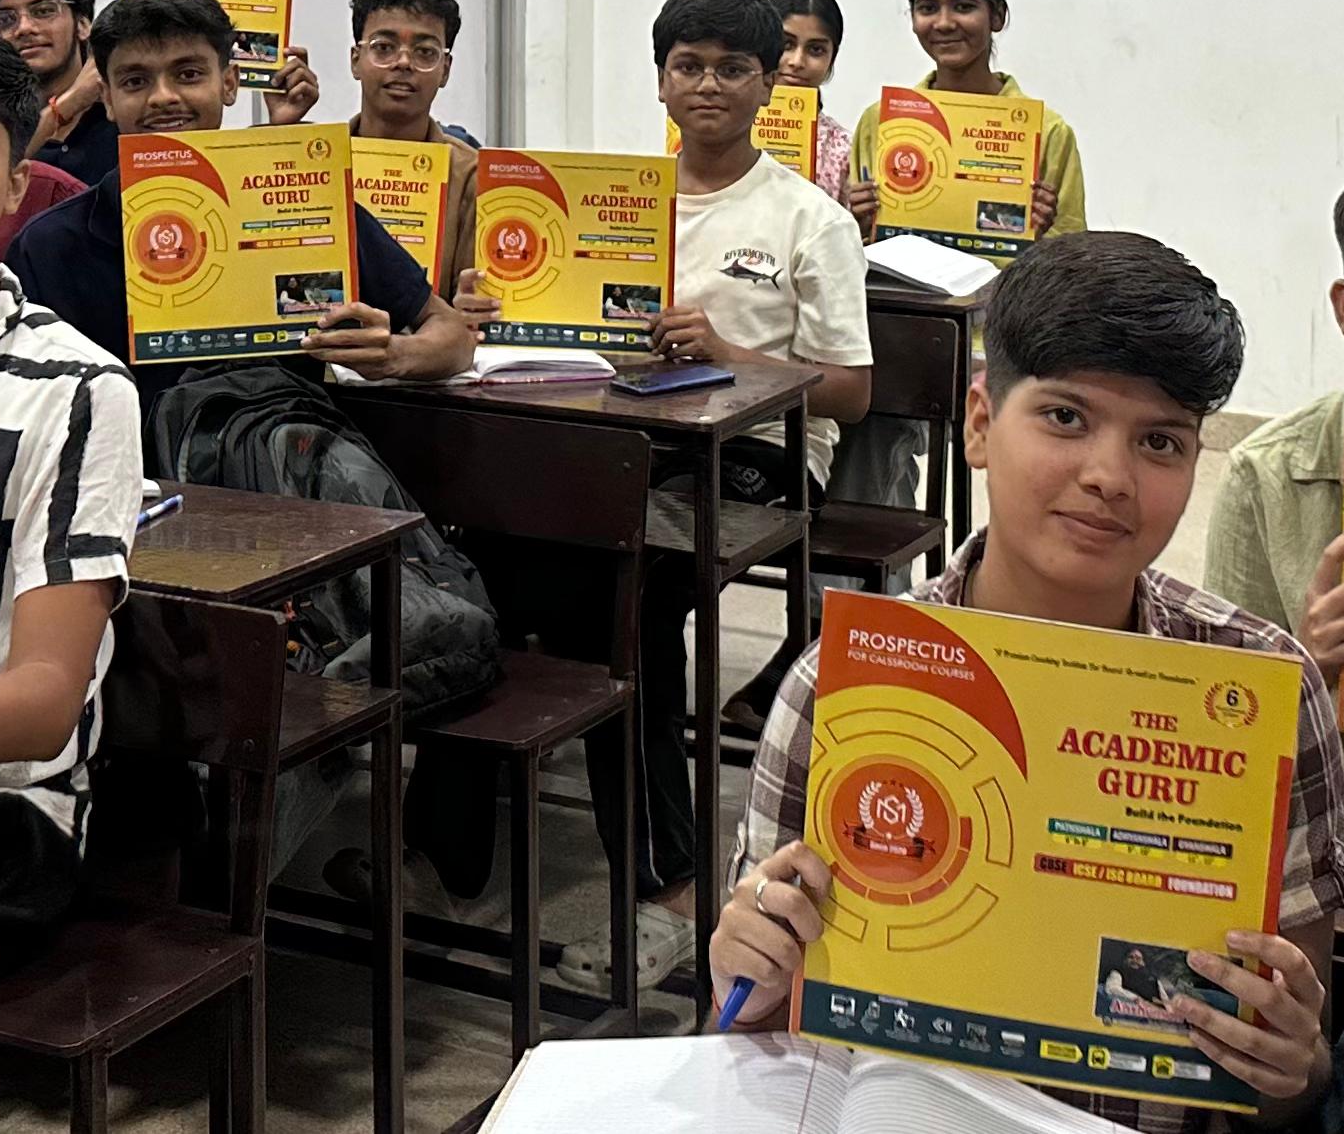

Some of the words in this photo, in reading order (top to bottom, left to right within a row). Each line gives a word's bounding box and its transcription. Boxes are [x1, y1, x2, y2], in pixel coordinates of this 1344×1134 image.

[754, 116, 803, 129] CADEMIC
[758, 128, 789, 139] GURU
[962, 127, 1025, 142] ACADEMIC
[975, 140, 1009, 153] GURU
[133, 150, 192, 162] PROSPECTUS
[273, 161, 296, 170] THE
[489, 163, 541, 174] PROSPECTUS
[241, 171, 330, 190] ACADEMIC
[354, 178, 429, 194] ACADEMIC
[609, 184, 629, 193] THE
[262, 190, 310, 206] GURU
[370, 193, 410, 206] GURU
[580, 194, 657, 209] ACADEMIC
[598, 210, 639, 223] GURU
[724, 248, 776, 267] RIVERMOUTH
[848, 629, 966, 664] PROSPECTUS
[847, 649, 866, 661] FOR
[930, 665, 975, 682] COURSES
[1226, 689, 1239, 707] 6
[1130, 710, 1178, 733] THE
[1057, 727, 1247, 778] ACADEMIC
[1098, 767, 1199, 806] GURU
[1125, 807, 1155, 821] Build
[1157, 811, 1175, 823] the
[1178, 815, 1243, 833] Foundation
[1072, 862, 1097, 879] ICSE
[1106, 867, 1125, 883] ISC
